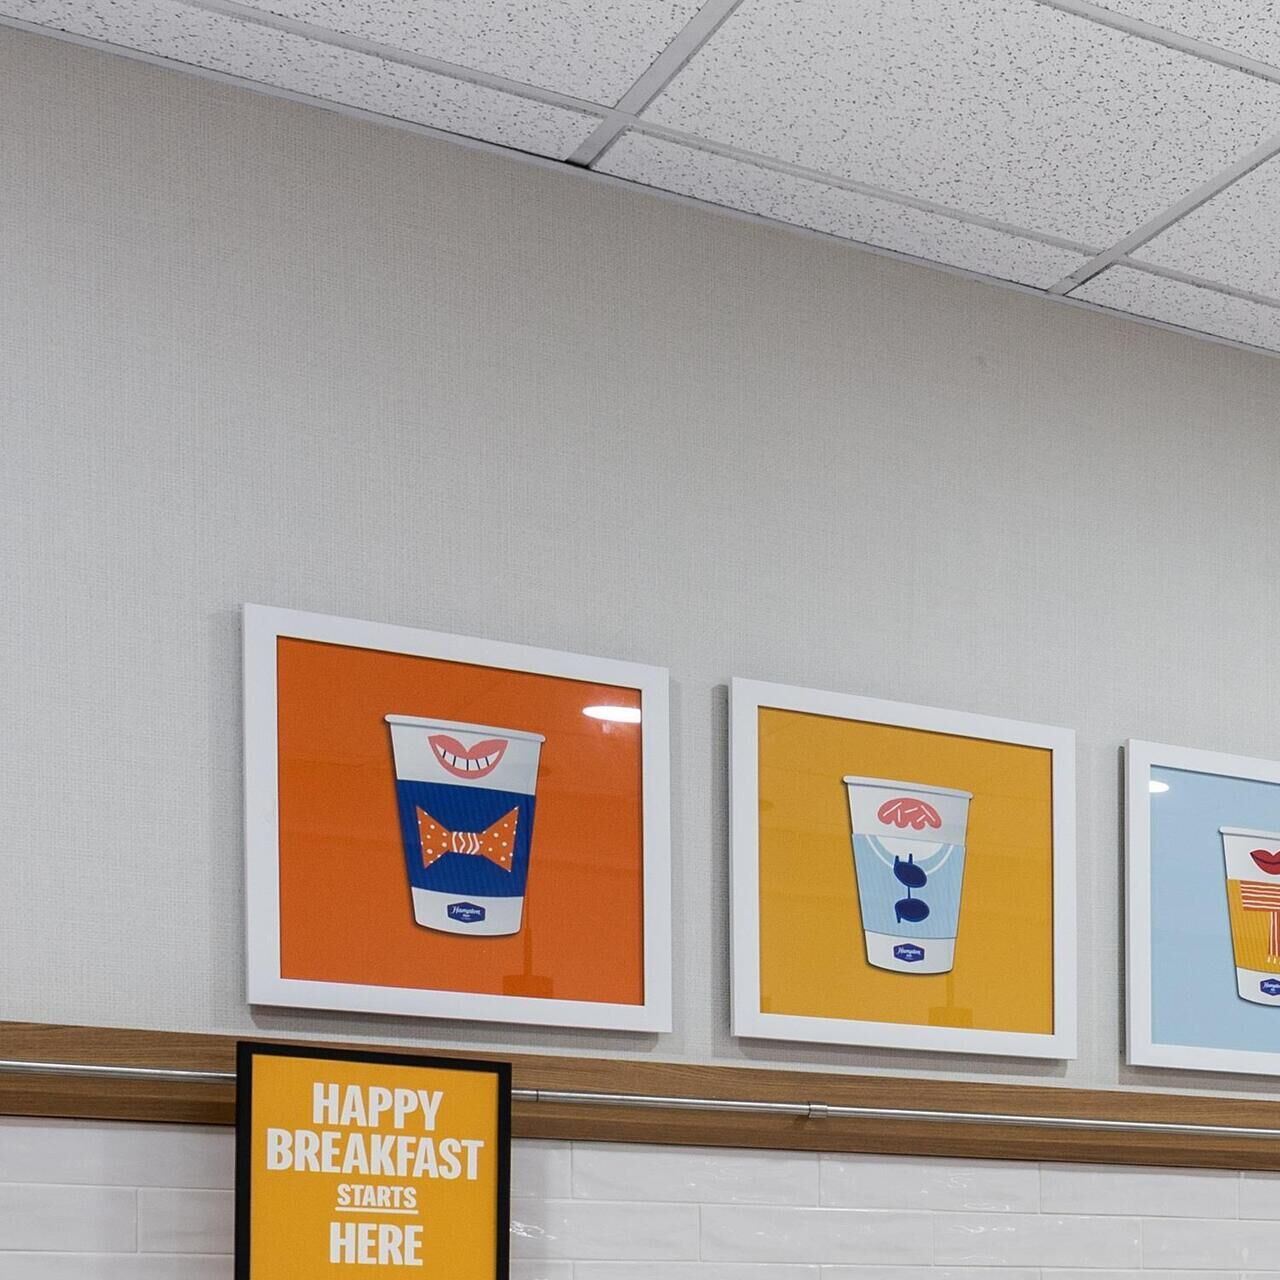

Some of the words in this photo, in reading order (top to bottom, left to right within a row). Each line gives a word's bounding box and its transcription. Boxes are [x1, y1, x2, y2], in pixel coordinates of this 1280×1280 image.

[312, 1081, 444, 1131] HAPPY
[265, 1127, 485, 1181] BREAKFAST
[337, 1183, 417, 1208] STARTS
[329, 1222, 424, 1267] HERE
